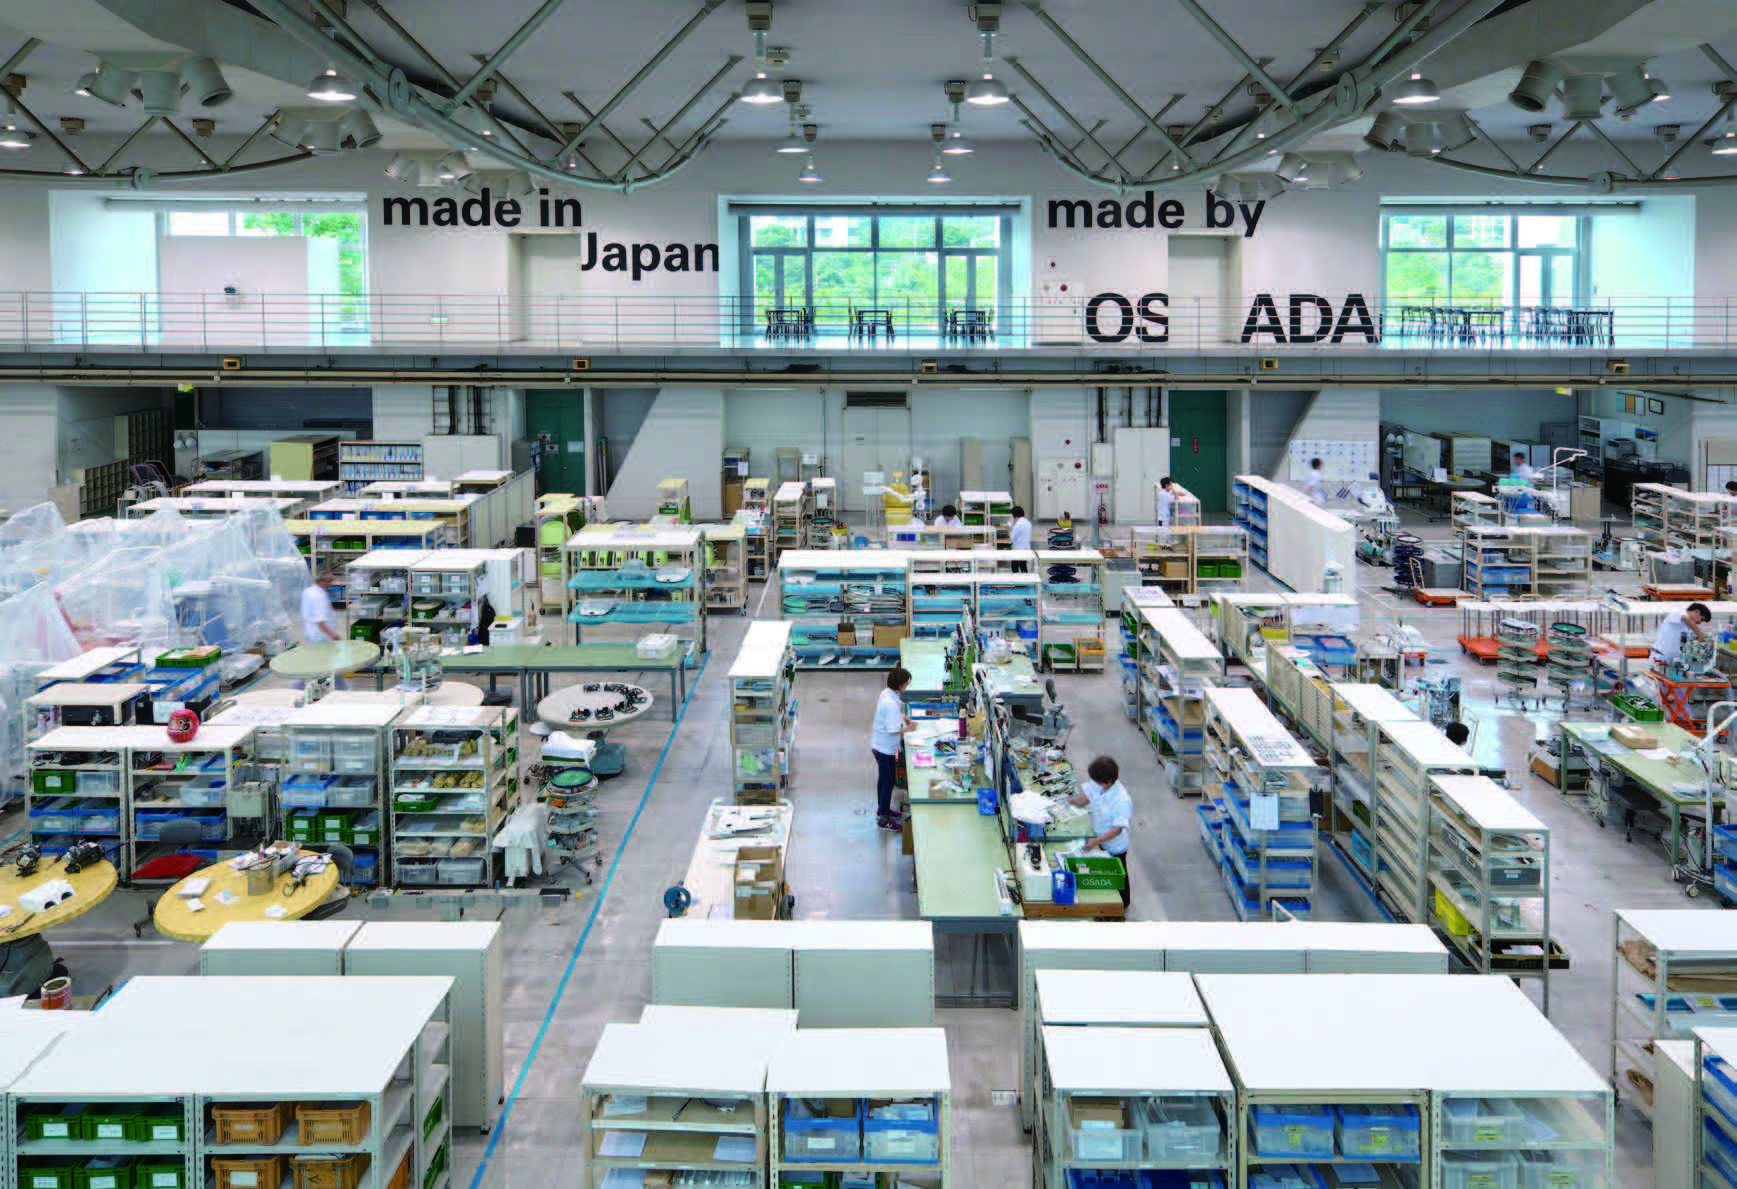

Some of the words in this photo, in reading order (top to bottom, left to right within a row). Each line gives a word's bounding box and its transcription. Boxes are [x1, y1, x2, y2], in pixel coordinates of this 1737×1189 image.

[383, 187, 521, 227] made
[540, 188, 582, 227] in
[1048, 190, 1185, 229] made
[1206, 189, 1266, 237] by
[581, 232, 719, 281] Japan
[1082, 878, 1112, 887] OSADA
